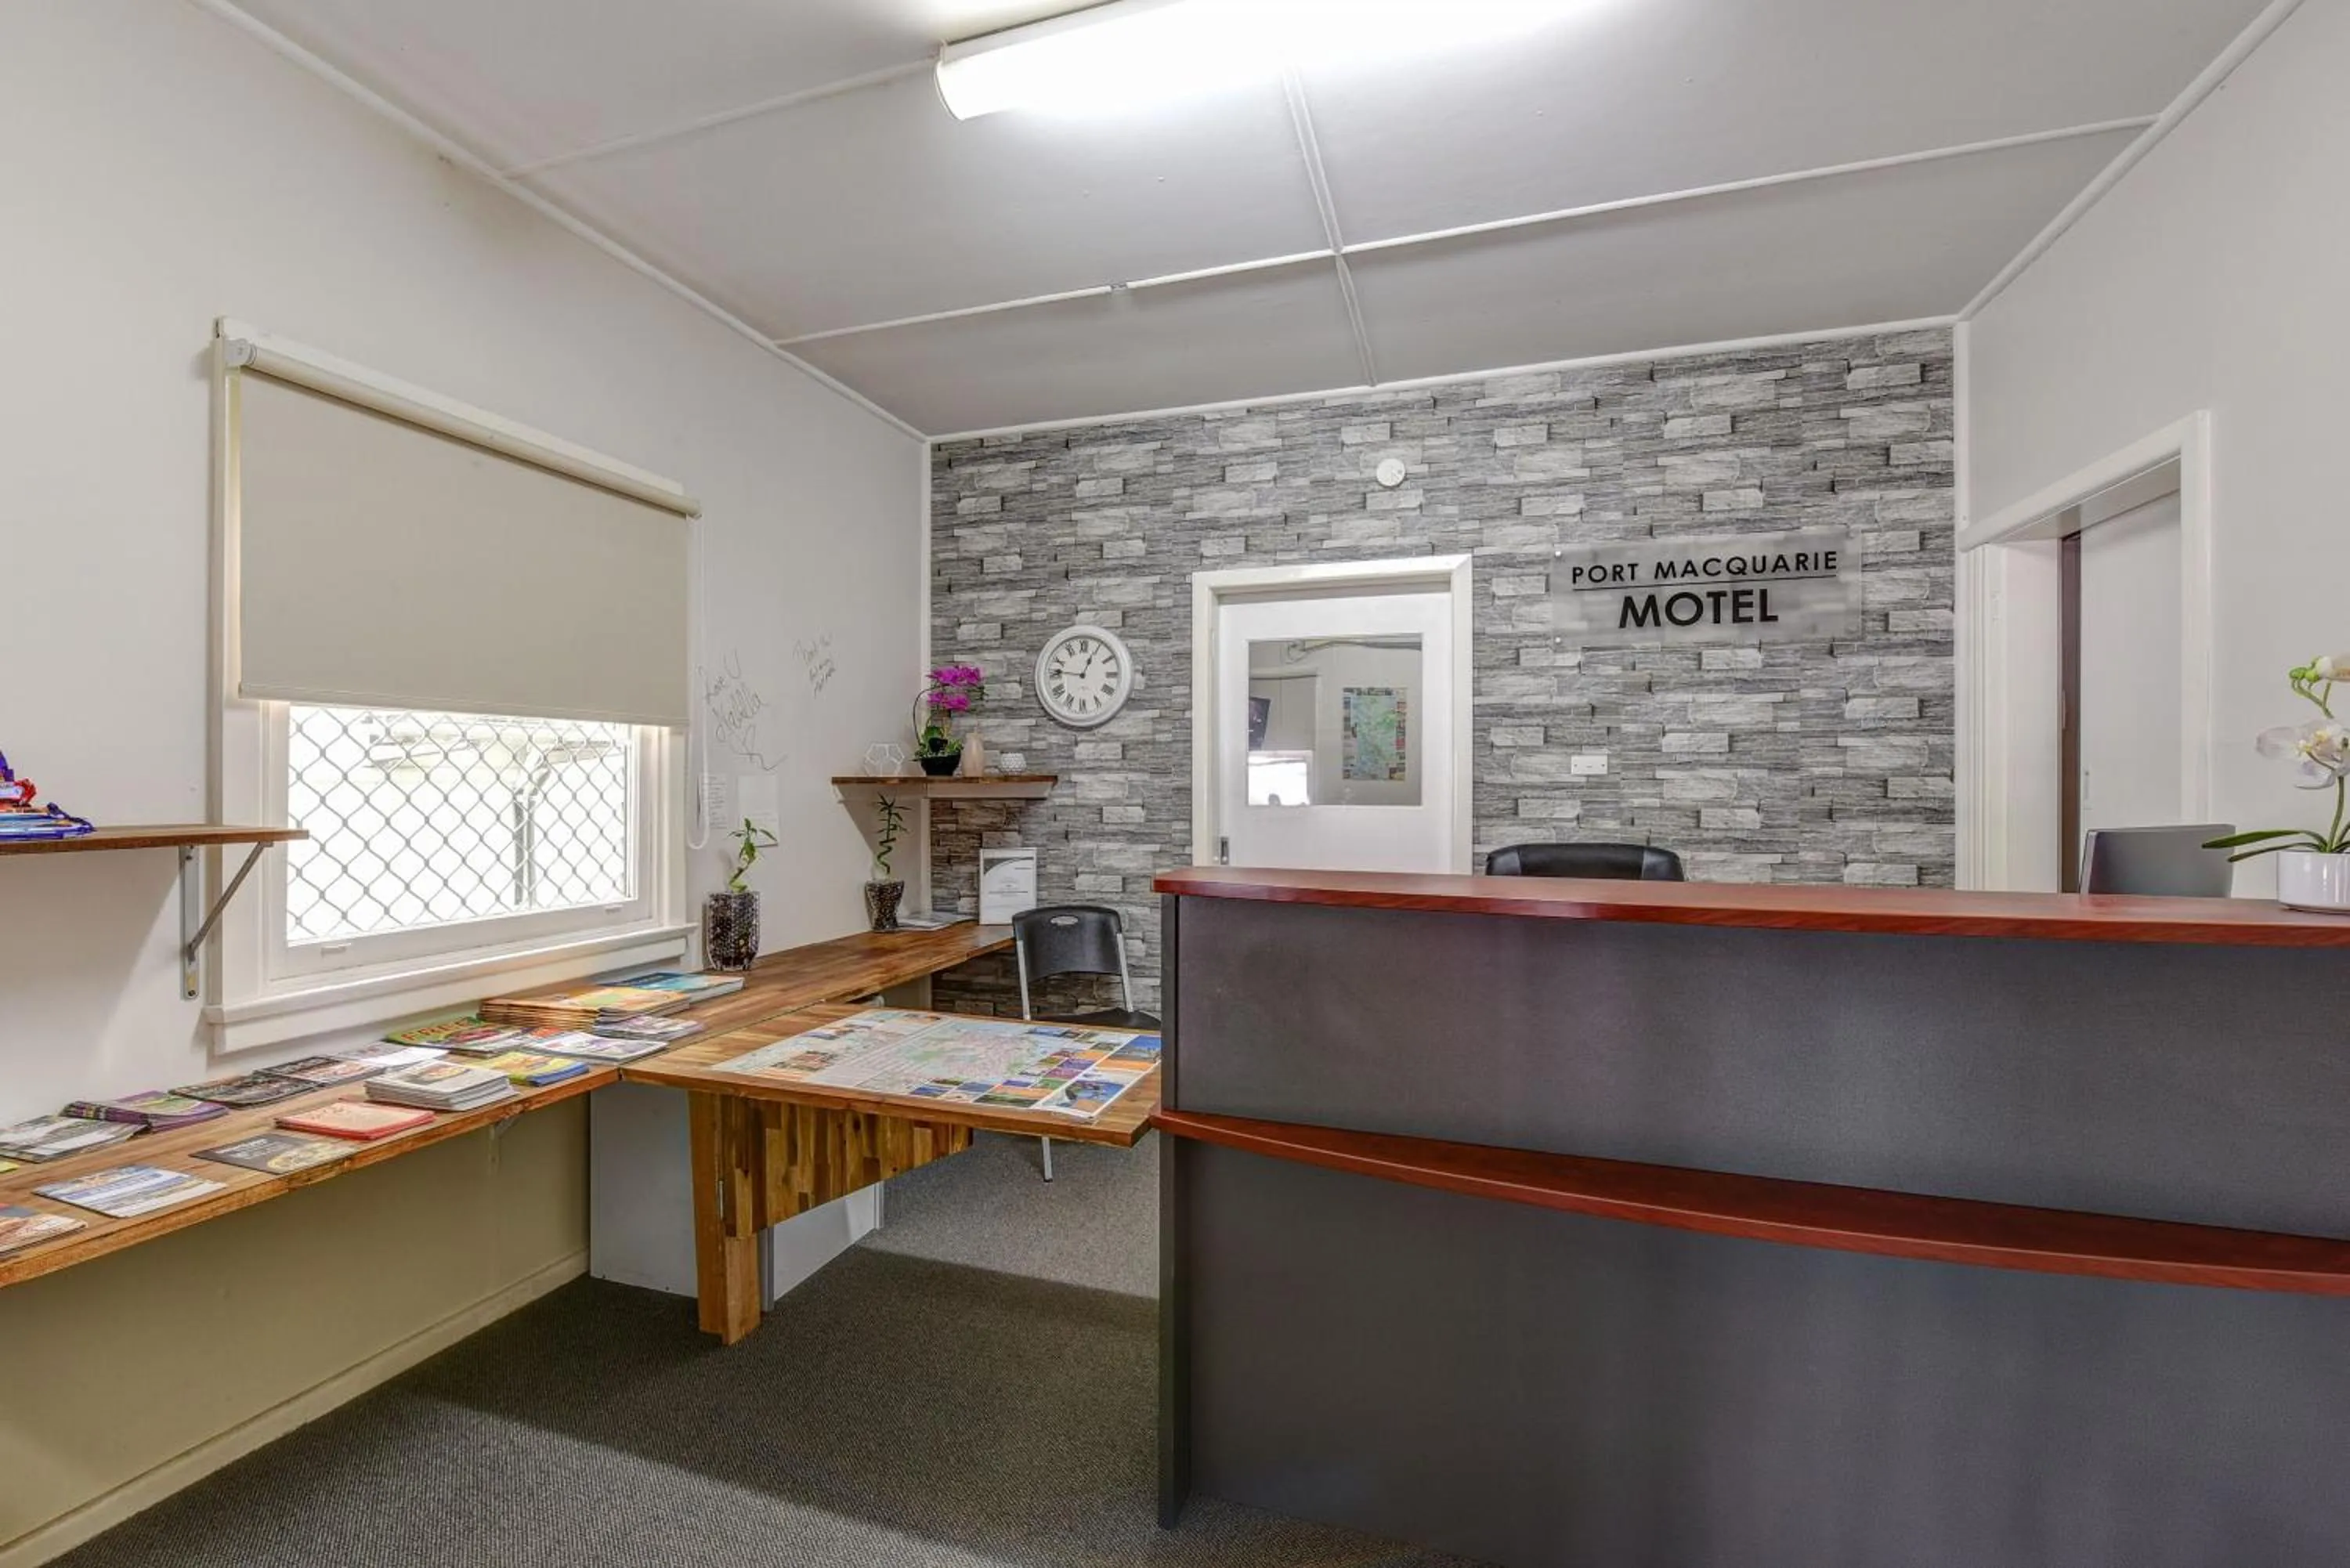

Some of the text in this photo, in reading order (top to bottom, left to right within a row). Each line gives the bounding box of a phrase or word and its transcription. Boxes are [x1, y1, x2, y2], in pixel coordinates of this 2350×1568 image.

[1571, 551, 1838, 584] PORT MACQUARIE
[1618, 588, 1779, 629] MOTEL
